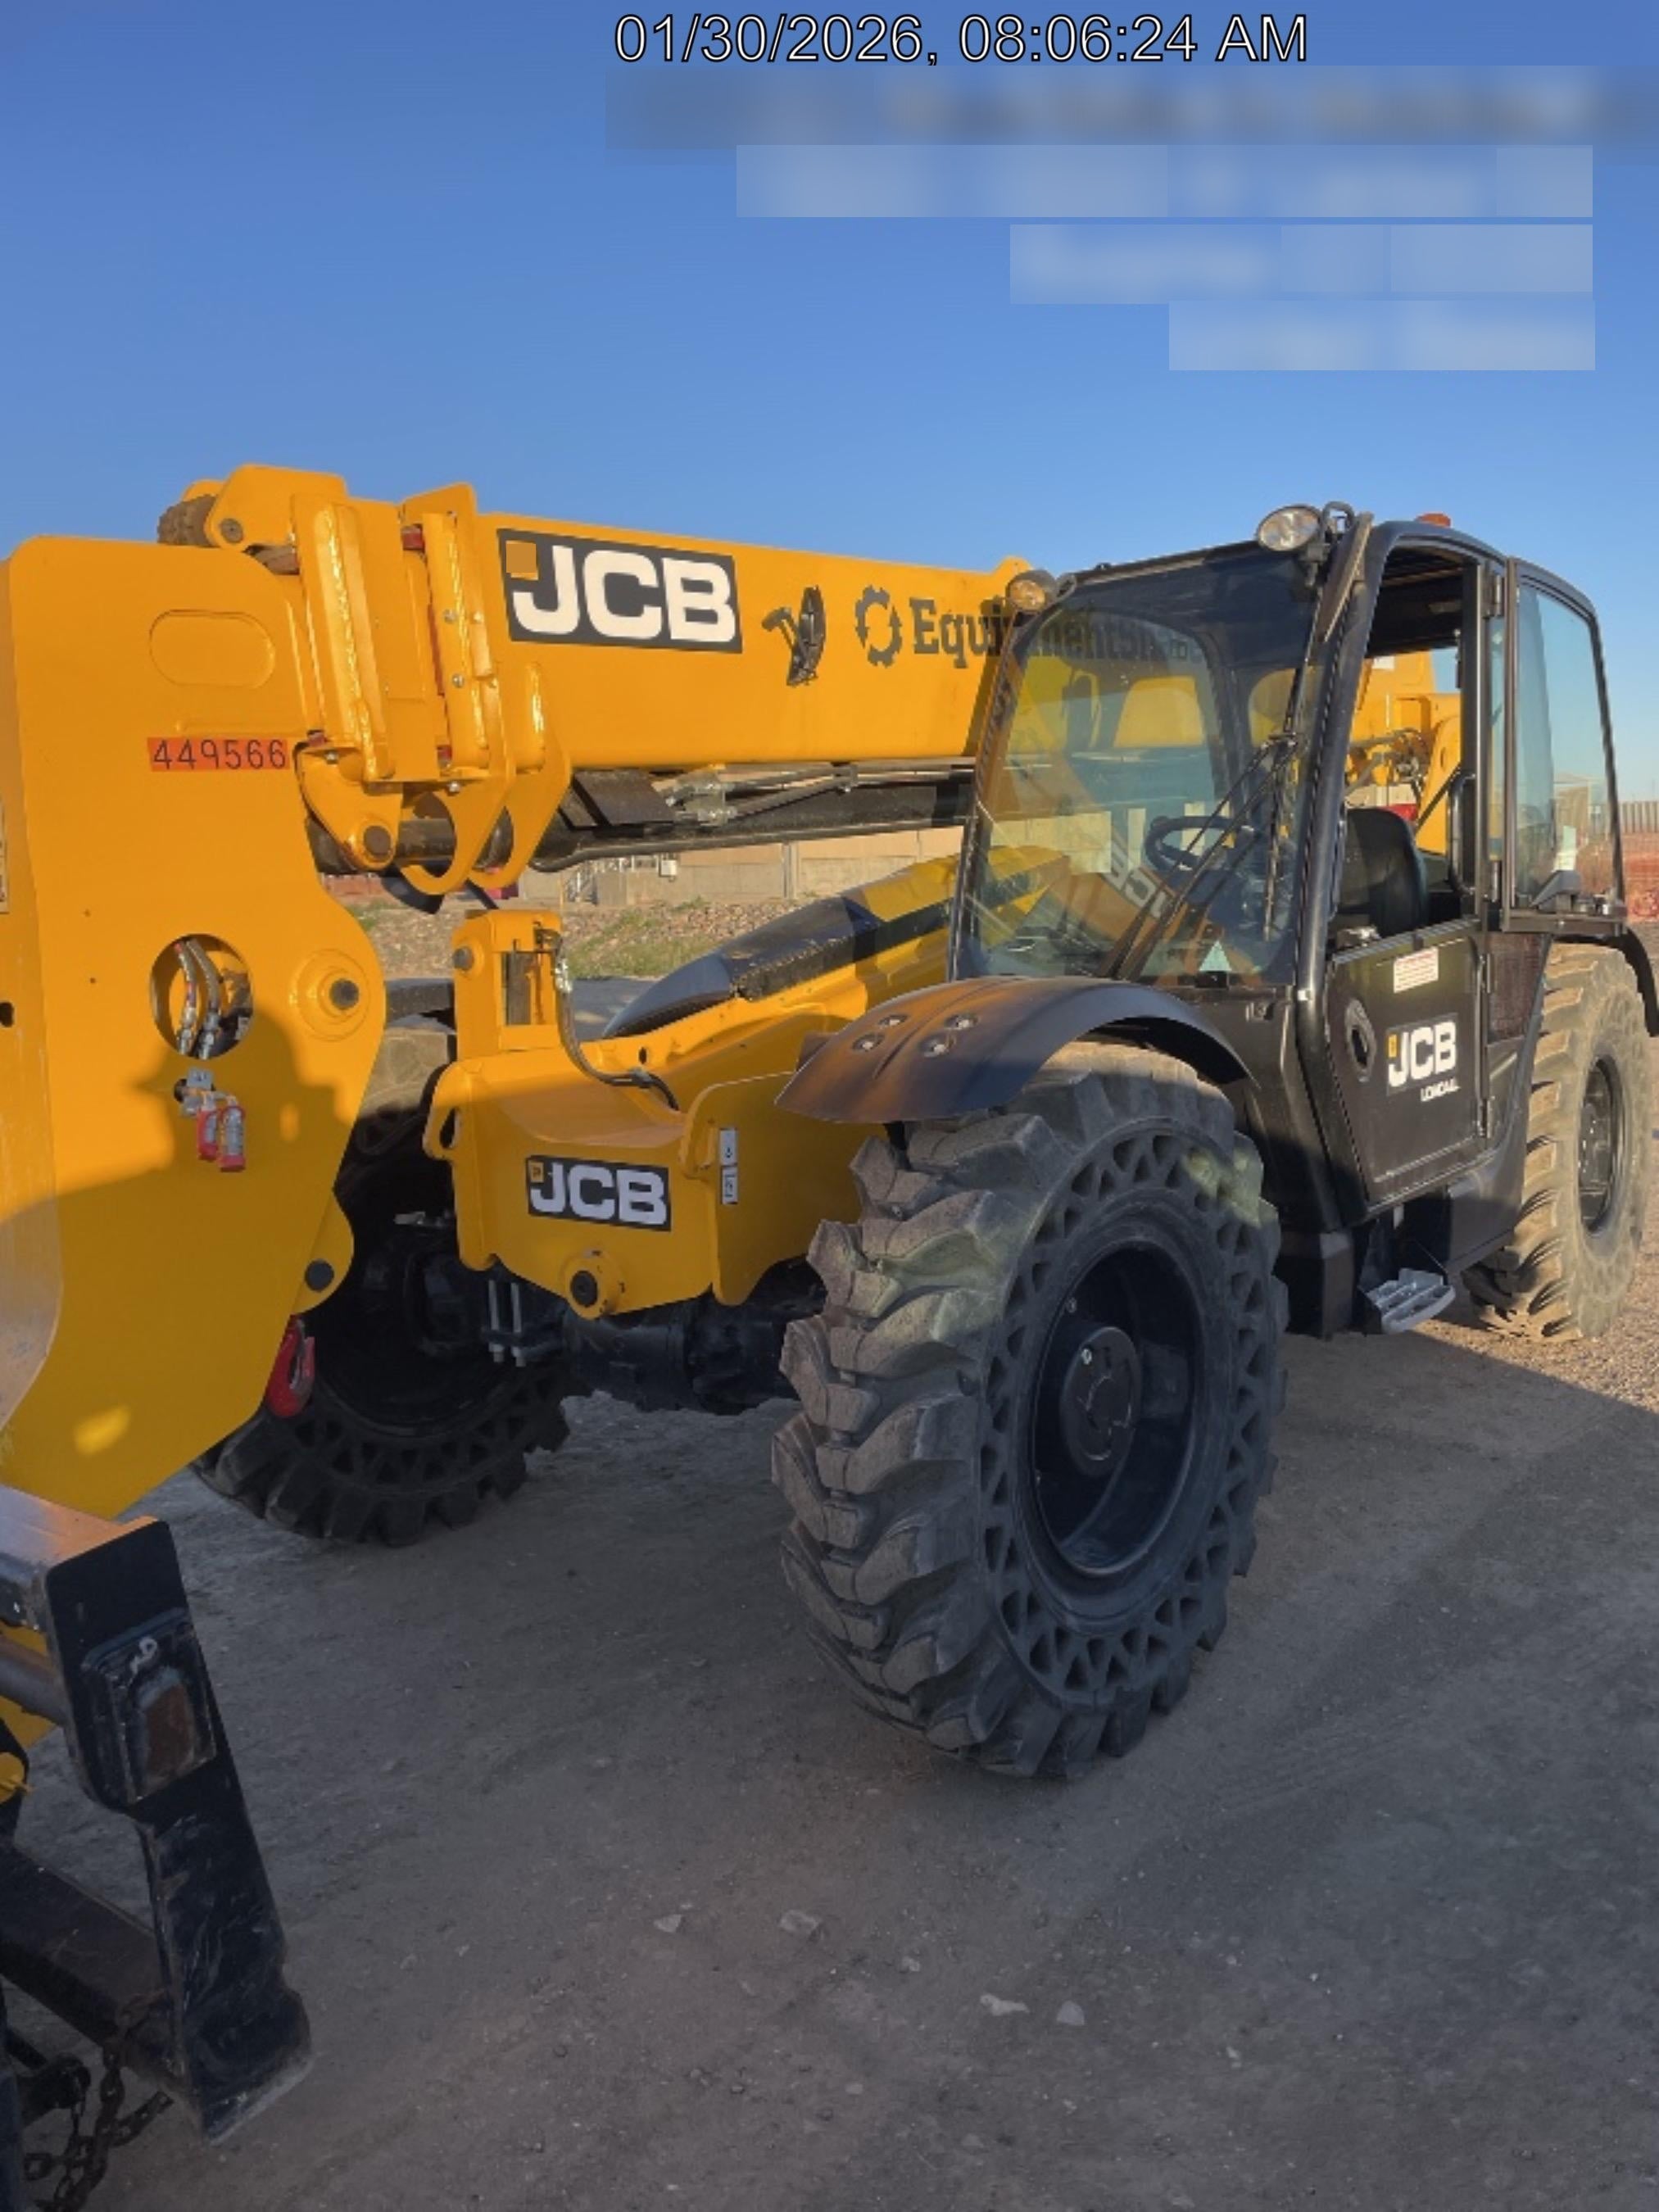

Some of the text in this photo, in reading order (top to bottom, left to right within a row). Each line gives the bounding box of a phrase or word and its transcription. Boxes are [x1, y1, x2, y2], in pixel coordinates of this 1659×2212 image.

[513, 545, 736, 642] JCB
[153, 739, 286, 769] 449566
[1388, 1021, 1457, 1088] JCB
[530, 1162, 668, 1226] JCB
